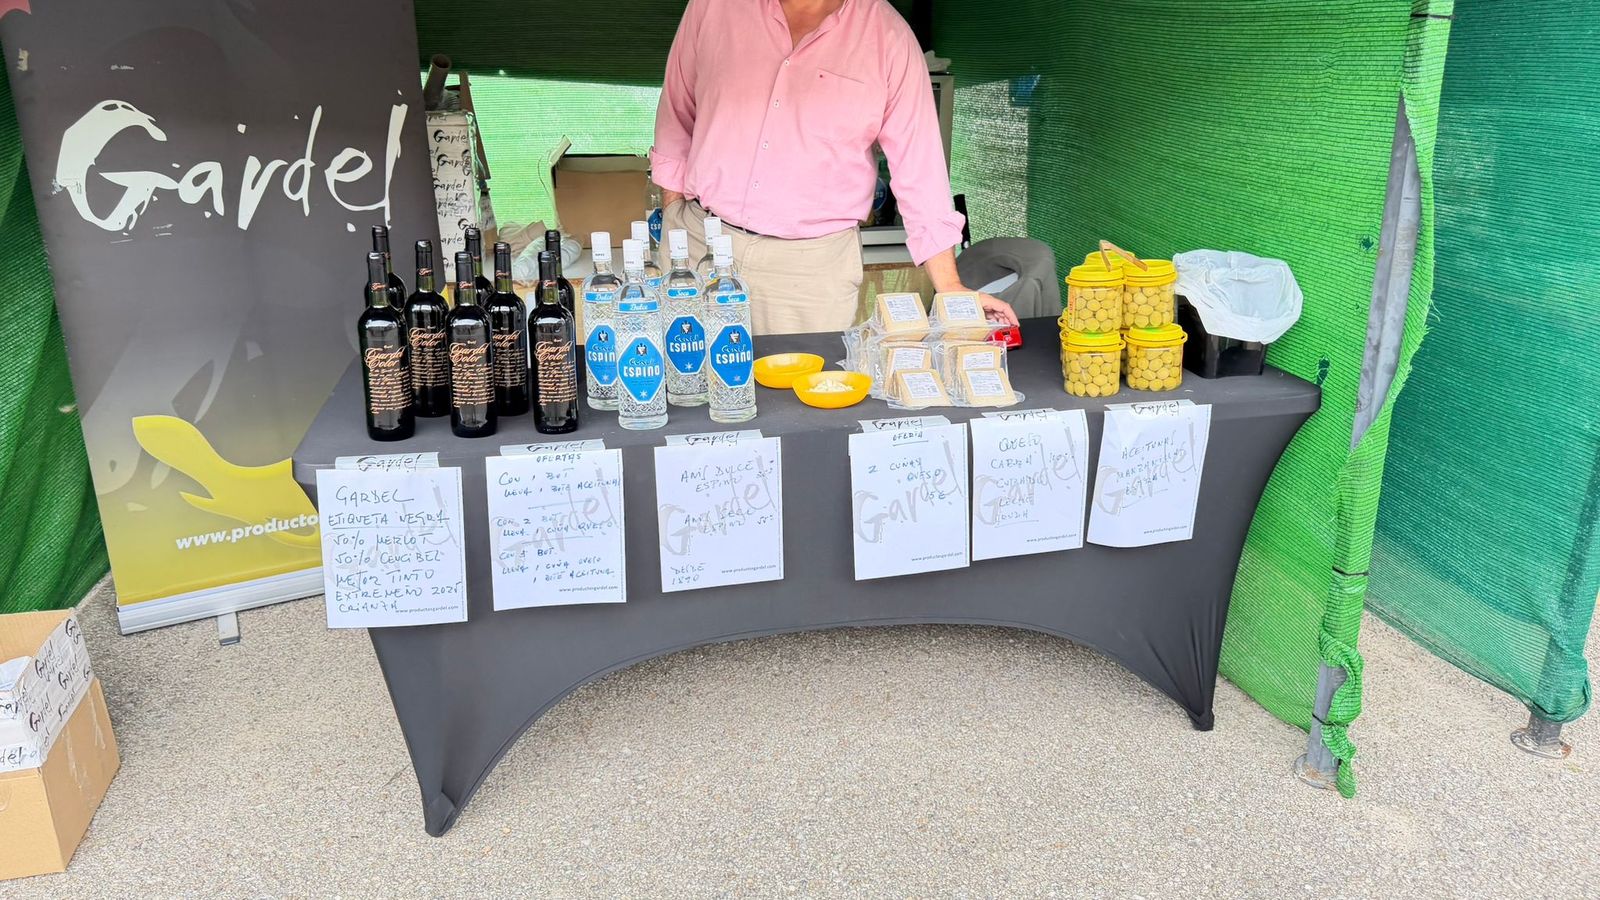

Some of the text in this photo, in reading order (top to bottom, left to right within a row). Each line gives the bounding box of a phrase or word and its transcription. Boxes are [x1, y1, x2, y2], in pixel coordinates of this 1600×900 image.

[55, 100, 408, 233] Gardel
[669, 340, 705, 353] ESPINO
[716, 351, 751, 365] ESPINO
[623, 365, 660, 378] ESPINO
[335, 486, 414, 507] GARDEL
[176, 513, 319, 549] www.producto
